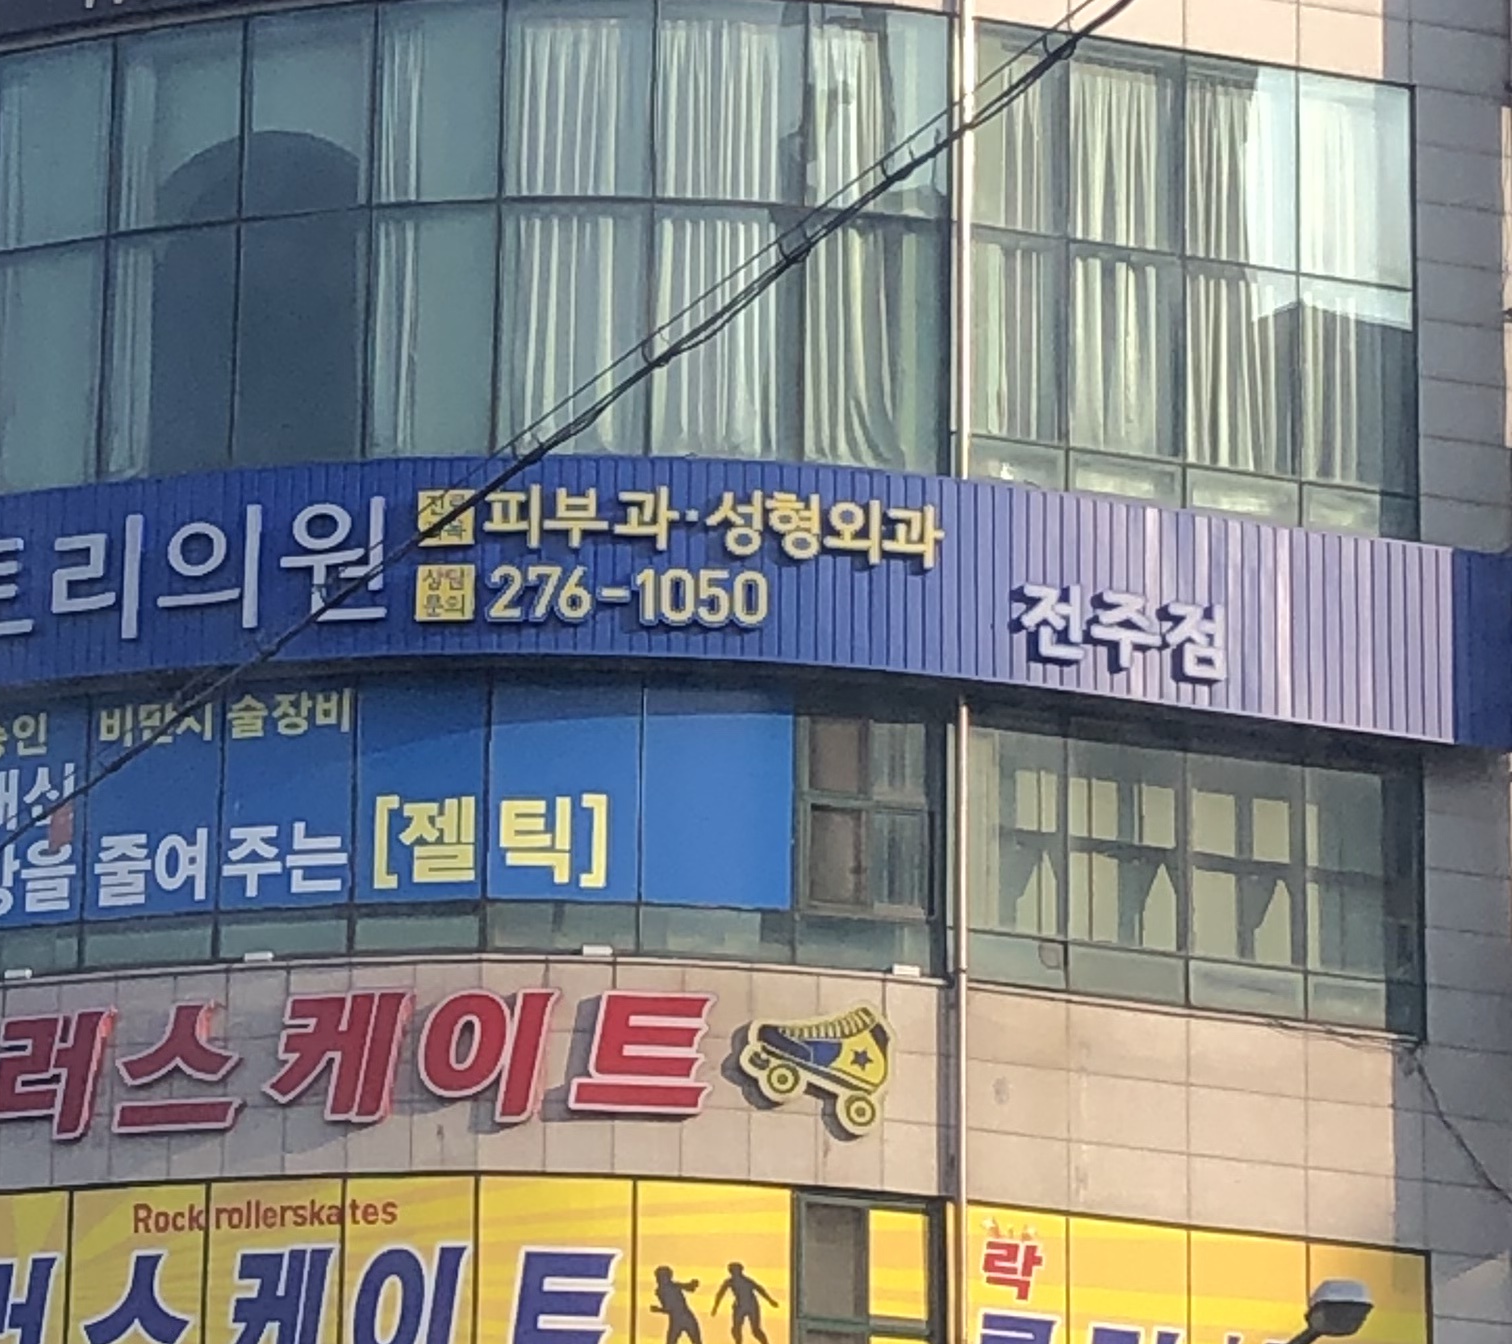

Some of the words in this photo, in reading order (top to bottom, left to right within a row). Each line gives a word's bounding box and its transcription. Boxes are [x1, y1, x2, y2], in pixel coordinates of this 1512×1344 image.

[487, 564, 770, 627] 276-1050
[1016, 582, 1228, 682] 전주점
[133, 1202, 205, 1234] Rock
[214, 1197, 399, 1232] rollerskates
